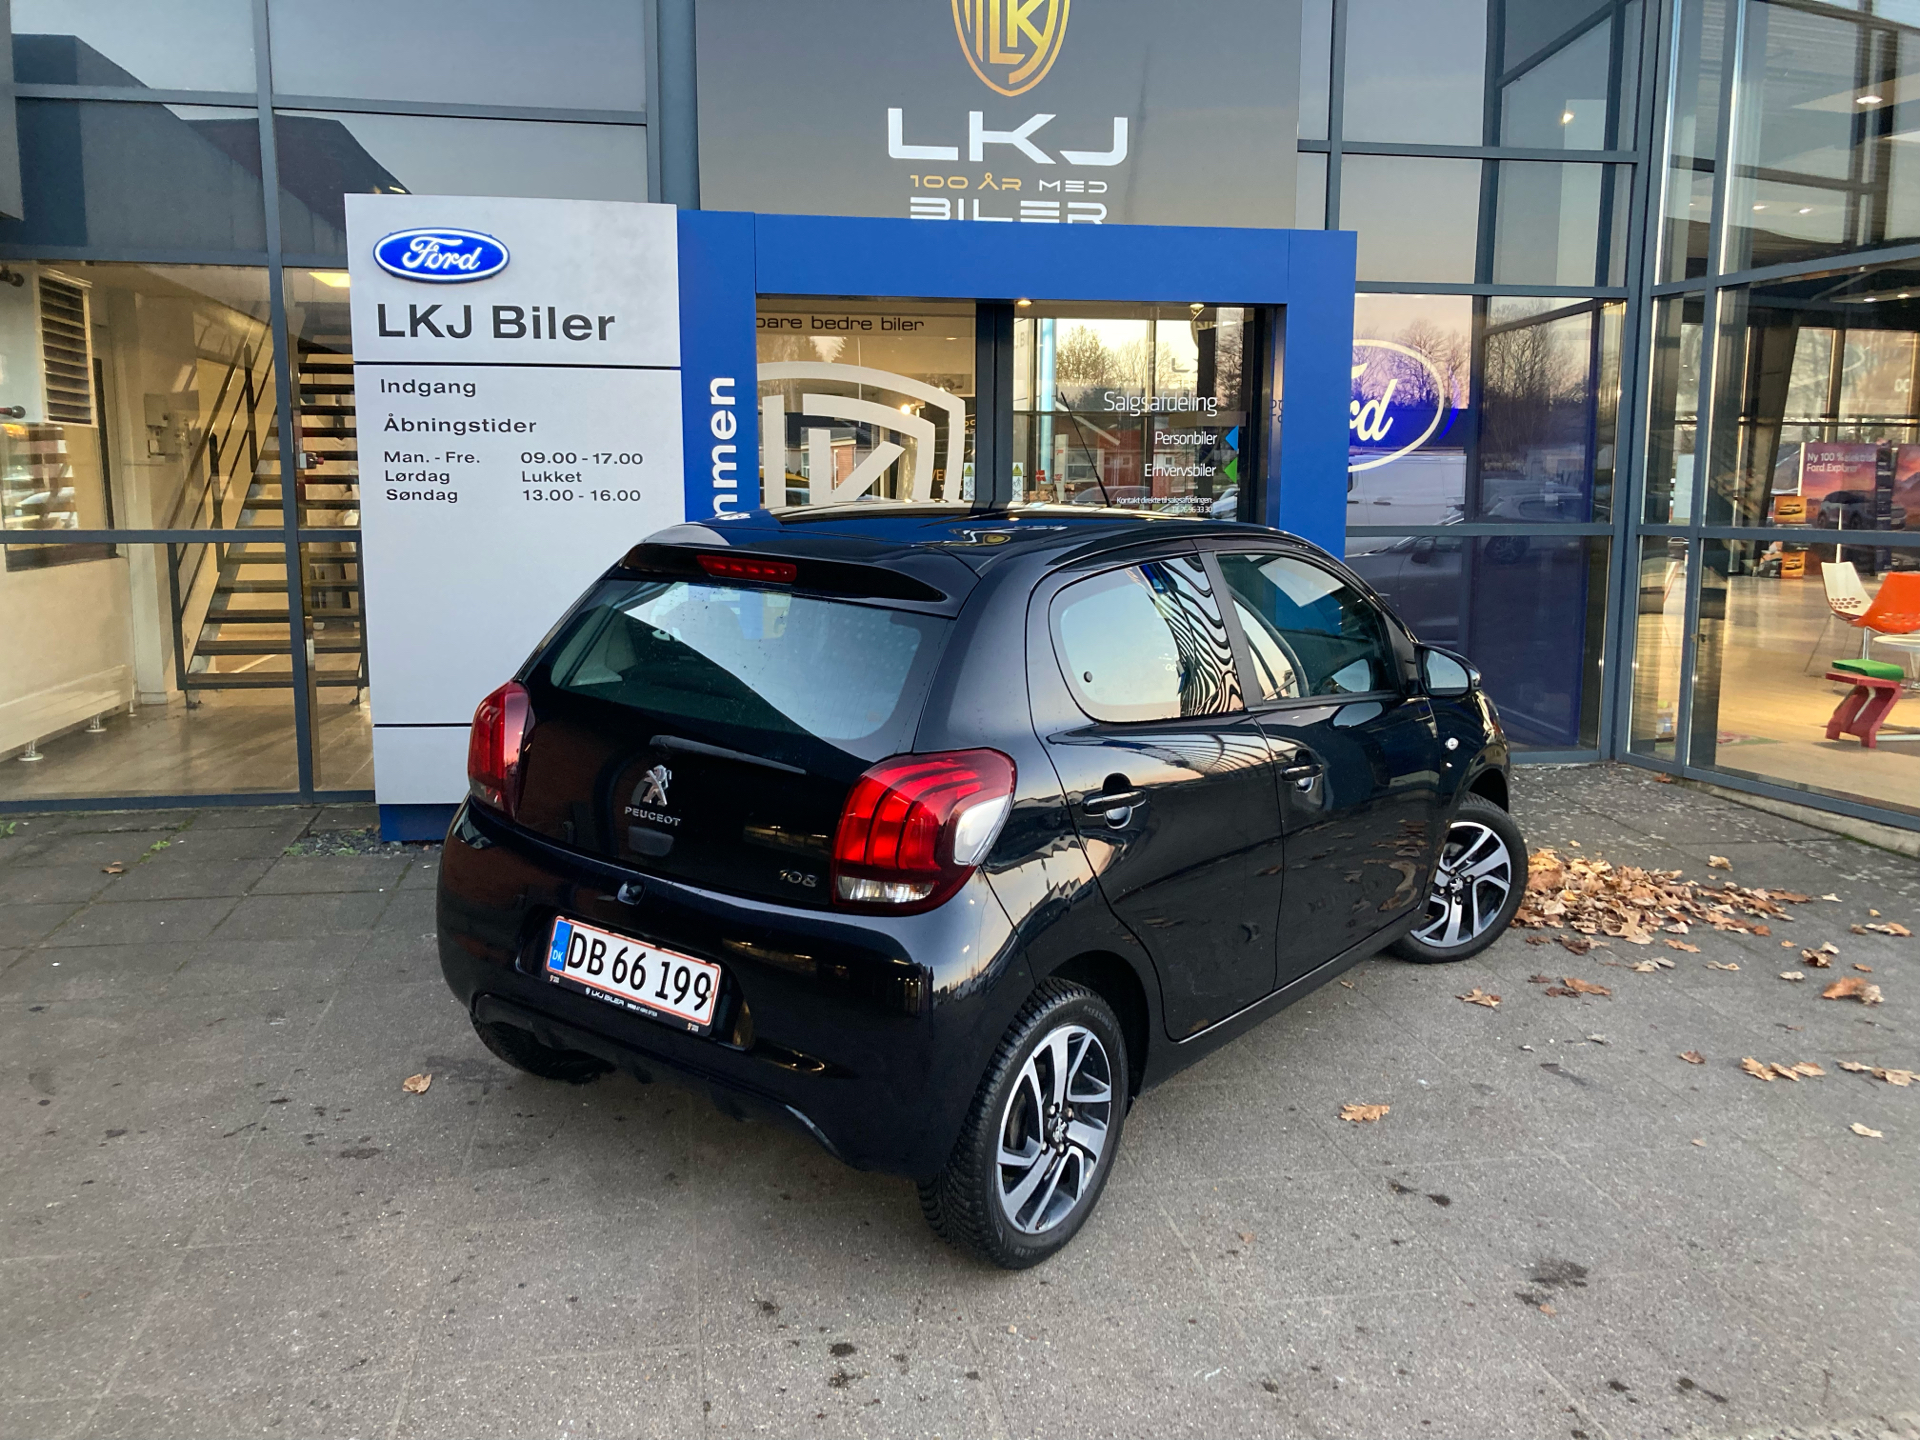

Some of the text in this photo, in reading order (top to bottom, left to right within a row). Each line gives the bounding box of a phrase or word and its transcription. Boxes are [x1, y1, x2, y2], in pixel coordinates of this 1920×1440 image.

[888, 108, 1128, 166] LKJ
[910, 172, 1108, 194] 100 ÅR MED
[910, 197, 1107, 225] BILER
[402, 236, 482, 271] Ford
[377, 303, 615, 341] LKJ Biler
[811, 316, 873, 331] bedre
[881, 317, 925, 332] biler
[380, 379, 477, 397] Indgang
[1103, 391, 1218, 417] Salgsafdeling
[384, 413, 537, 436] Åbningstider
[1154, 431, 1218, 446] Personbiler
[384, 451, 430, 463] Man.
[445, 451, 480, 464] Fre.
[520, 452, 577, 464] 09.00
[592, 453, 644, 465] 17.00
[1807, 453, 1819, 463] Ny
[1820, 453, 1835, 462] 100
[384, 470, 583, 484] Lørdag Lukket
[1144, 463, 1217, 477] Erhvervsbiler
[1806, 464, 1825, 472] Ford
[386, 489, 458, 503] Søndag
[522, 490, 573, 502] 13.00
[590, 490, 642, 502] 16.00
[624, 806, 681, 827] PEUGEOT
[779, 869, 819, 888] 108
[552, 949, 564, 963] DK
[567, 931, 712, 1011] DB 66 199
